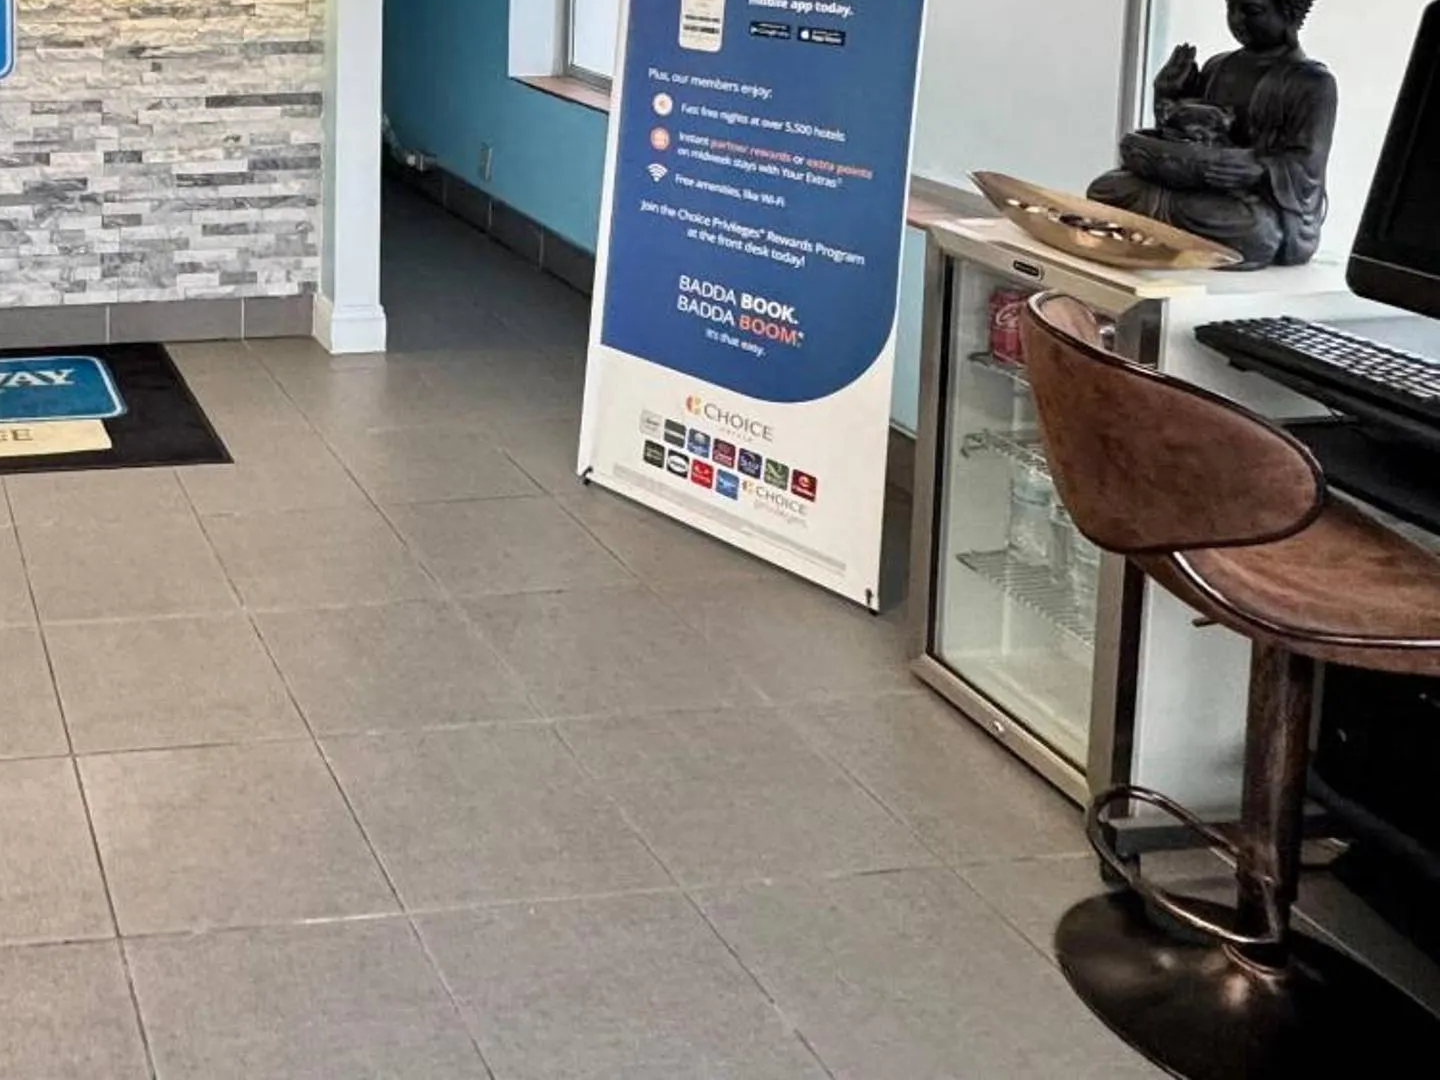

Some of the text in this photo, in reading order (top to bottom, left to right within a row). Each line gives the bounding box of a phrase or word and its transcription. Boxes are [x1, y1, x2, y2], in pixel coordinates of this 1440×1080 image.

[790, 0, 813, 14] app
[815, 1, 854, 18] today.
[648, 67, 670, 82] Plus,
[672, 73, 689, 84] our
[691, 76, 739, 92] members
[701, 105, 719, 119] free
[720, 111, 749, 124] nights
[761, 119, 783, 131] over
[677, 147, 689, 158] on
[691, 150, 731, 166] midweek
[733, 159, 757, 172] stays
[758, 164, 780, 176] with
[782, 167, 805, 181] Your
[750, 147, 792, 163] rewards
[793, 155, 804, 165] or
[675, 173, 694, 187] Free
[761, 193, 786, 208] Wi-Fi
[640, 200, 659, 213] Join
[661, 204, 676, 217] the
[677, 208, 711, 226] Choice
[767, 231, 813, 253] Rewards
[815, 242, 865, 265] Program
[687, 228, 805, 269] at the front desk today!
[677, 294, 735, 327] BADDA
[679, 275, 799, 325] BADDA BOOK.
[720, 332, 740, 348] that
[704, 403, 774, 442] CHOICE
[755, 485, 808, 515] CHOICE
